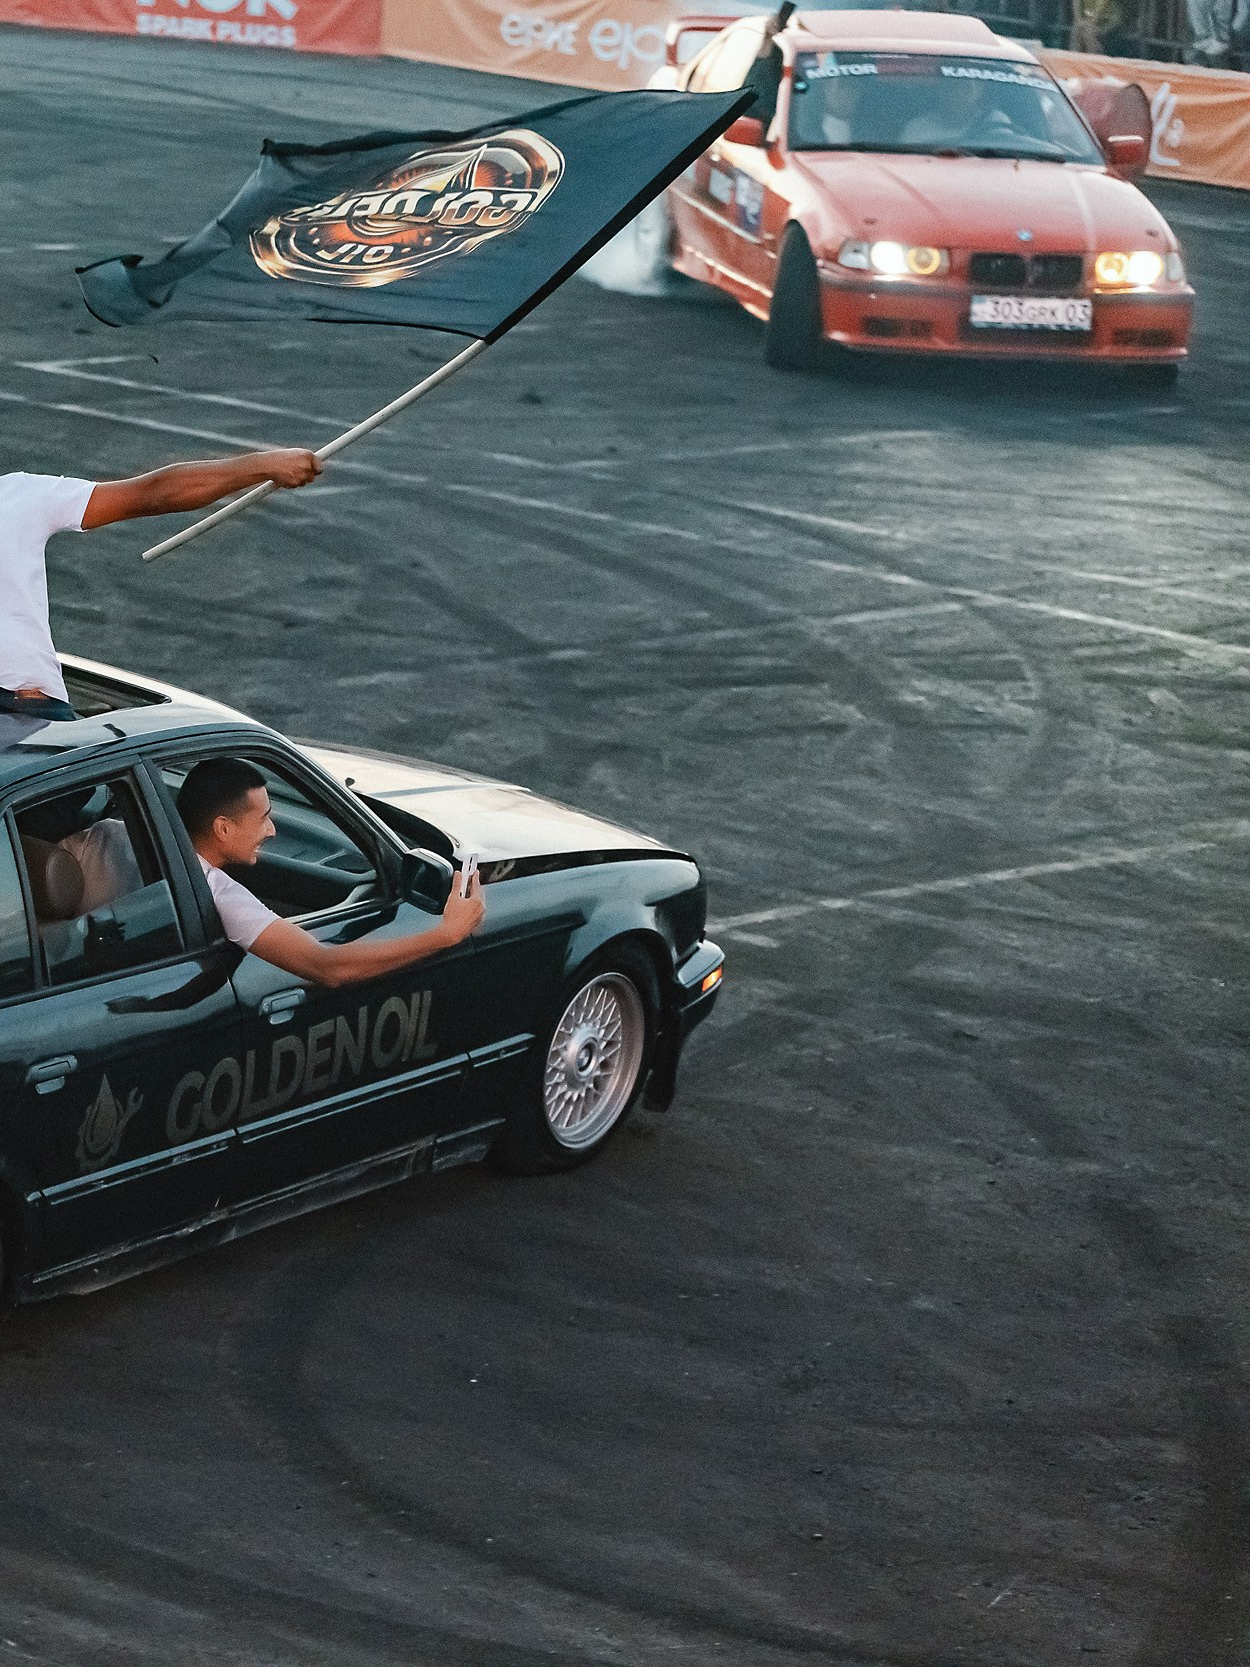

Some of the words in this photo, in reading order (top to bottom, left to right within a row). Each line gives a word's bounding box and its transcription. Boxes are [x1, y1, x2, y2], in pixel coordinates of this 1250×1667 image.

[137, 14, 212, 40] SPARK
[216, 20, 297, 47] PLUGS
[806, 63, 878, 79] MOTOR
[166, 1005, 368, 1144] GOLDEN
[371, 990, 438, 1069] OIL
